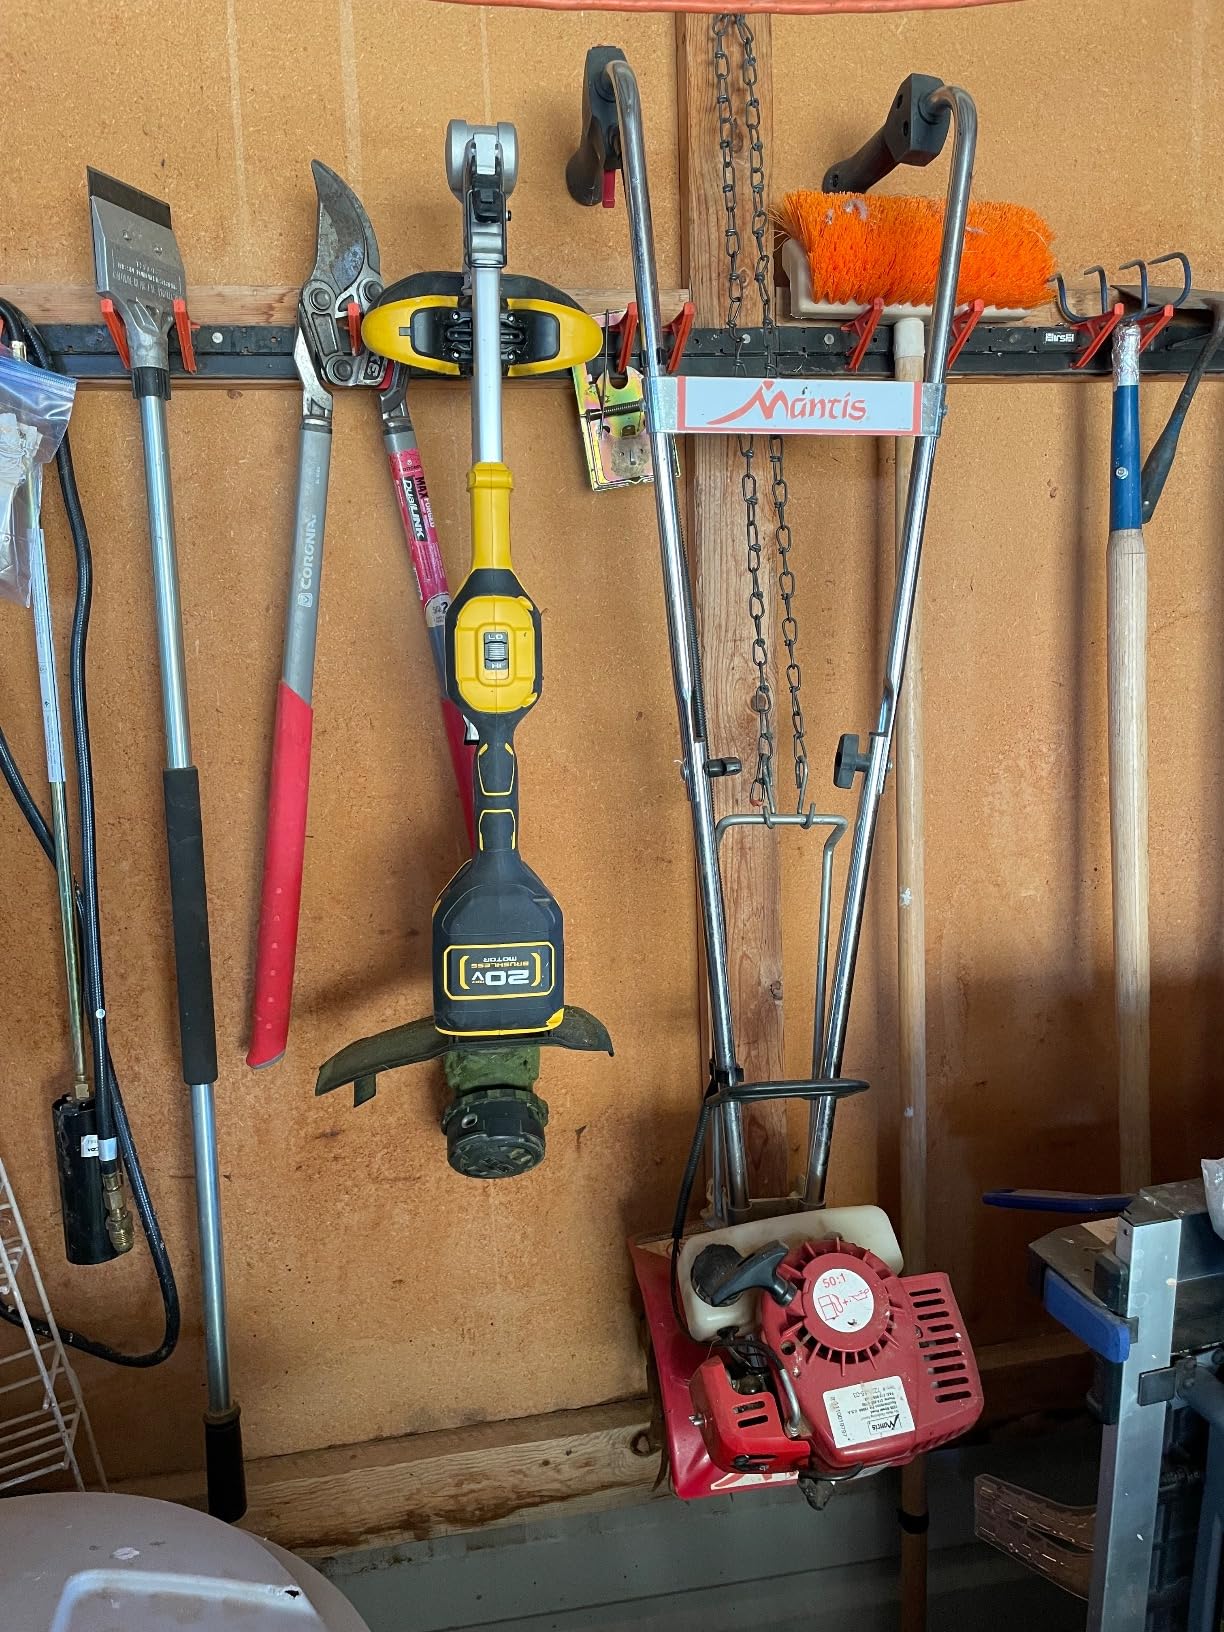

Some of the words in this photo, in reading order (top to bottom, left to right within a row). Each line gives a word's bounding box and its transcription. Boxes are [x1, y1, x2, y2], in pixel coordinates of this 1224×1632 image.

[706, 380, 867, 426] Mantis
[415, 477, 429, 499] MAX
[470, 960, 530, 969] BRUSHLESS
[823, 1272, 846, 1289] 50:1
[871, 1414, 900, 1431] Mantis
